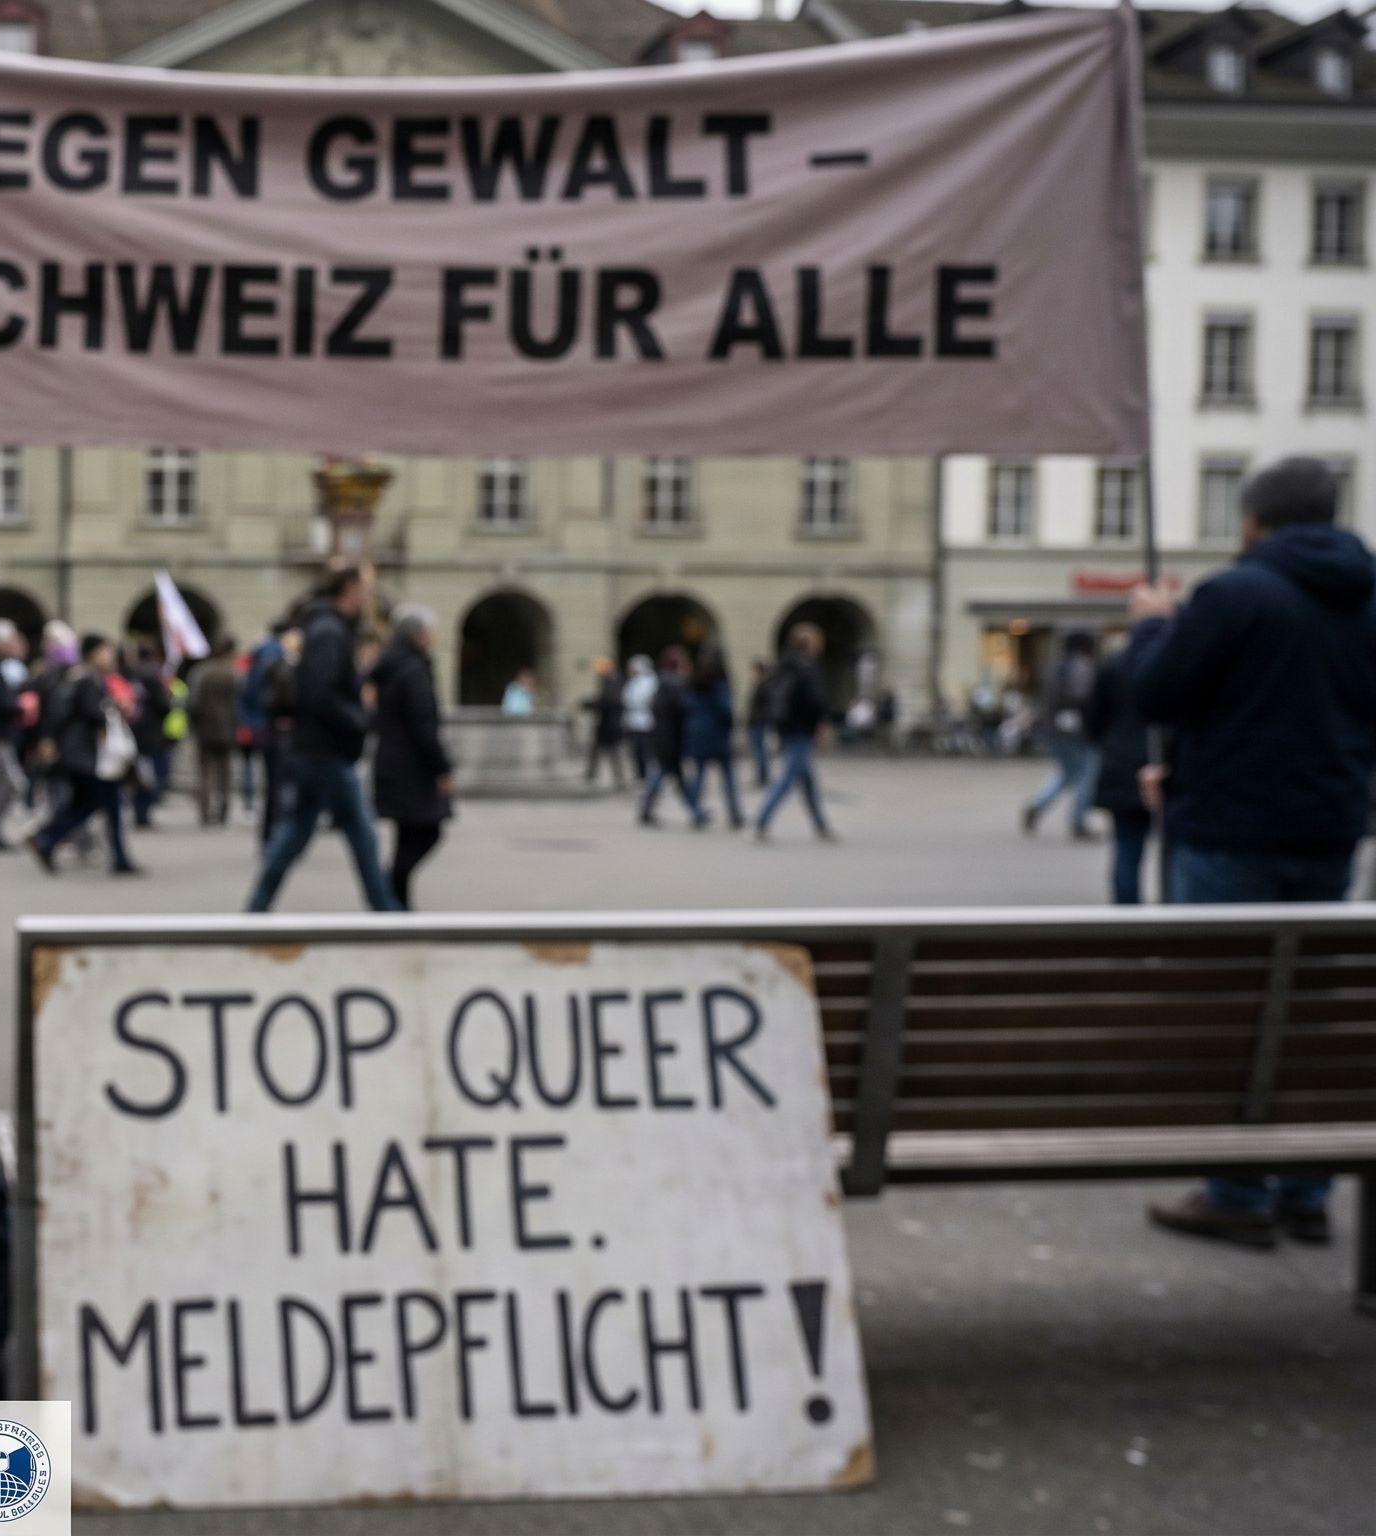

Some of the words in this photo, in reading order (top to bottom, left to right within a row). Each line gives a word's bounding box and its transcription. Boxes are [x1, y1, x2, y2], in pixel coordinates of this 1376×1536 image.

[304, 109, 774, 204] GEWALT
[437, 246, 667, 365] FÜR
[704, 261, 1000, 366] ALLE
[104, 988, 399, 1120] STOP
[447, 986, 776, 1110] QUEER
[282, 1134, 606, 1257] HATE.
